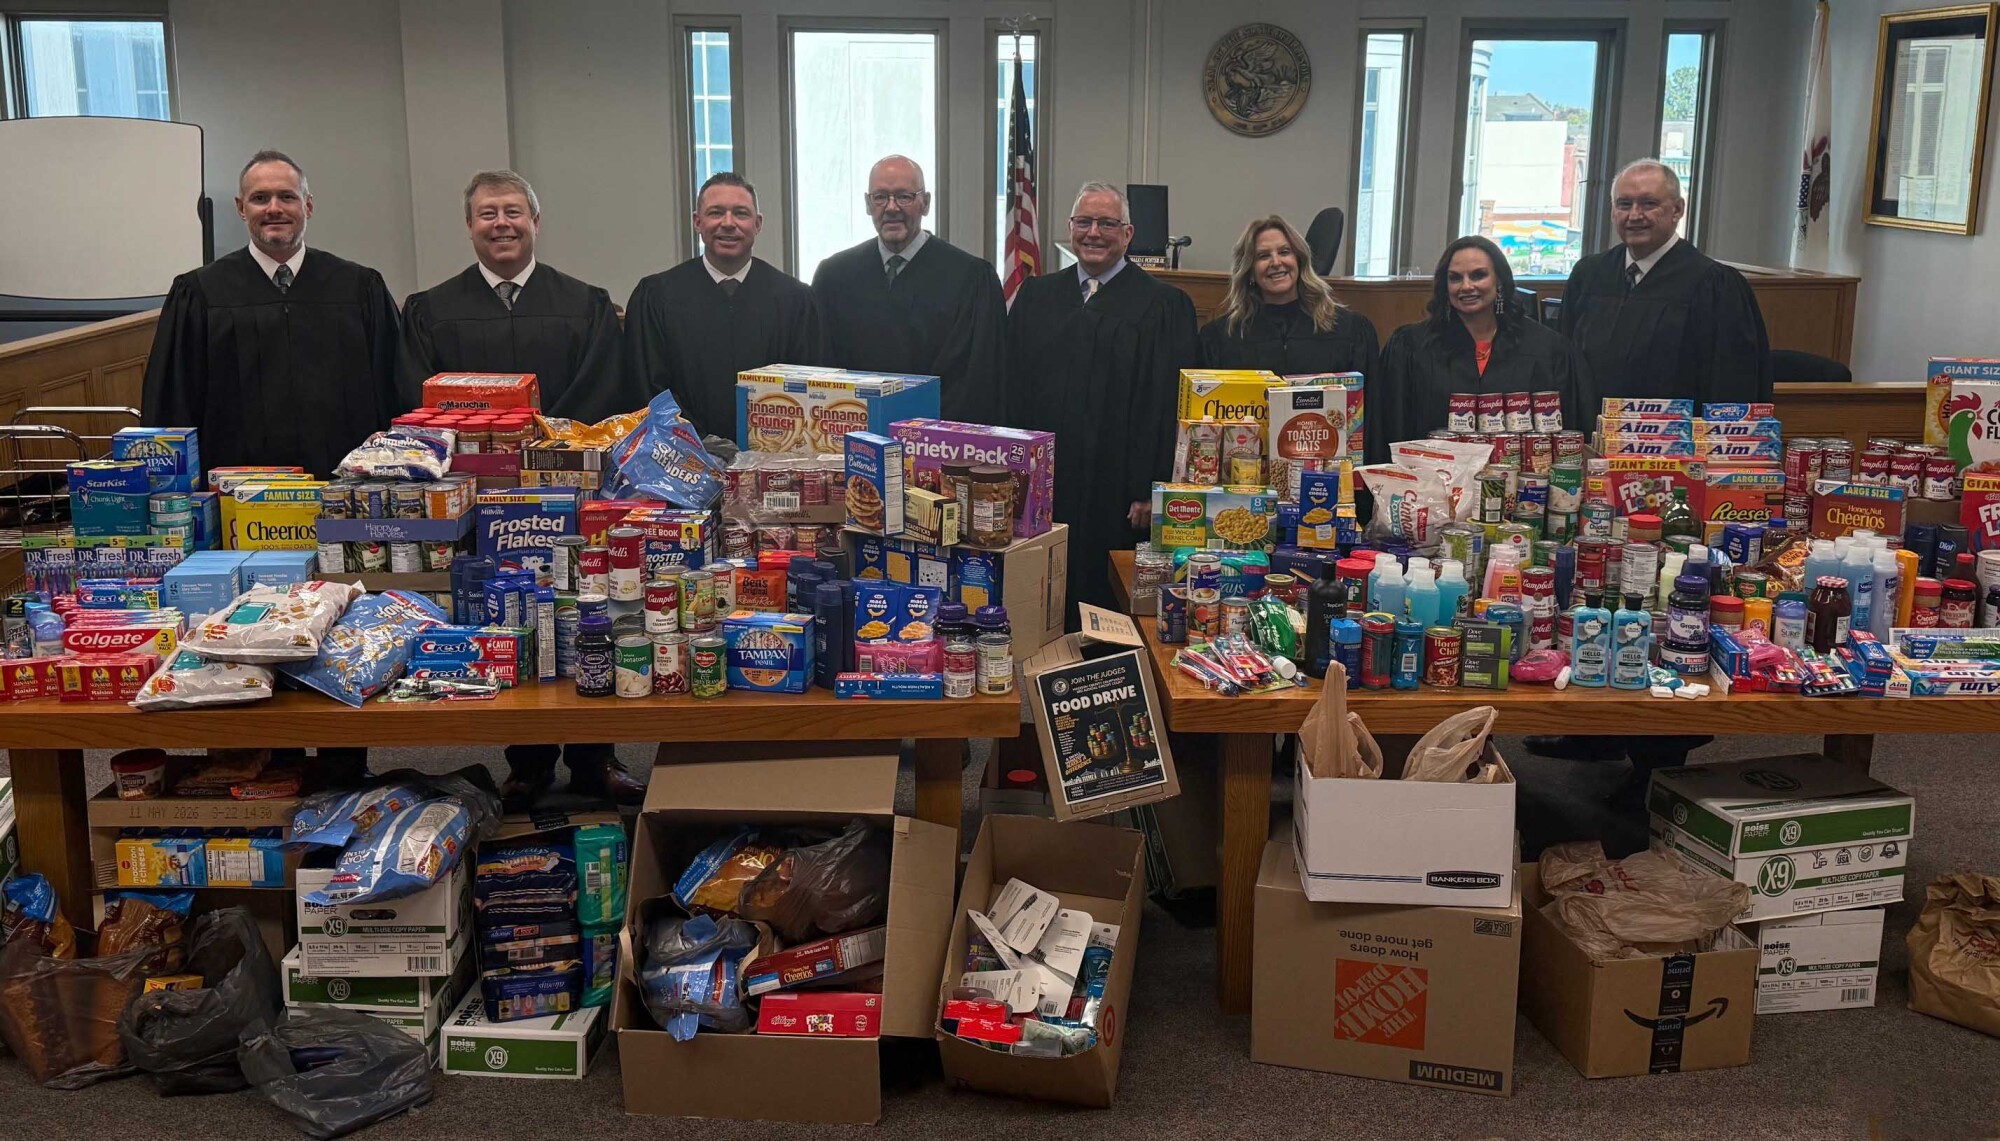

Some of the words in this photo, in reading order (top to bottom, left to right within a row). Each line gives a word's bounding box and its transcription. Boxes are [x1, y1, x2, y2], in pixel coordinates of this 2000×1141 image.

[1943, 365, 1979, 375] GIANT
[1982, 366, 2000, 375] SIZ
[739, 374, 761, 383] FAMILY
[808, 380, 831, 388] FAMILY
[832, 381, 846, 389] SIZE
[447, 401, 490, 409] Maruchan
[1620, 400, 1663, 413] Aim
[811, 405, 867, 422] Cinnamo
[750, 413, 796, 429] CRUNCH
[1617, 421, 1660, 434] Aim
[1707, 423, 1749, 436] Aim
[1287, 429, 1329, 440] TOASTED
[893, 436, 959, 461] Variety
[963, 443, 1008, 466] Pack
[1011, 445, 1023, 455] 25
[1296, 440, 1320, 452] OATS
[1557, 442, 1580, 450] CHUNKY
[1620, 441, 1663, 455] Aim
[1708, 442, 1750, 455] Aim
[657, 444, 682, 466] OAT
[1608, 460, 1645, 470] GIANT
[1649, 460, 1676, 470] SIZE
[1826, 457, 1850, 465] CHUNKY
[650, 452, 703, 485] BLENDERS
[87, 479, 128, 488] StarKist
[1732, 475, 1757, 483] LARGE
[1760, 474, 1778, 483] SIZE
[1966, 479, 2000, 490] GIAN
[264, 491, 294, 501] FAMILY
[296, 490, 315, 500] SIZE
[1843, 485, 1870, 497] LARGE
[1871, 488, 1890, 499] SIZE
[91, 495, 110, 503] Chunk
[111, 495, 126, 504] Light
[1254, 497, 1262, 506] 8
[1168, 505, 1180, 513] Del
[1180, 505, 1201, 514] Monte
[1591, 511, 1611, 519] HEARTY
[1711, 501, 1772, 522] Reese's
[1784, 505, 1808, 514] CHUNKY
[1848, 505, 1868, 516] Honey
[1869, 506, 1882, 515] Nut
[1826, 508, 1886, 529] Cheerios
[246, 522, 317, 541] Cheerios
[365, 523, 393, 533] Happy
[489, 515, 566, 539] Frosted
[1589, 523, 1609, 531] Chicken
[370, 531, 405, 539] Harvest
[496, 532, 556, 552] Flakes
[1939, 541, 1954, 551] Dial
[130, 550, 148, 561] DR.
[150, 549, 181, 561] Fresh
[646, 552, 685, 563] ROSTED
[743, 576, 768, 588] Ben's
[743, 587, 768, 595] Original
[81, 594, 116, 603] Crest
[737, 595, 759, 606] Ready
[759, 595, 775, 606] Rice
[11, 600, 23, 610] 2
[8, 624, 28, 636] SPEED
[1680, 622, 1701, 630] Grape
[161, 633, 169, 643] 3
[1781, 629, 1801, 638] Sure
[68, 632, 143, 649] Colgate
[492, 640, 514, 649] CAVITY
[420, 641, 467, 654] Crest
[623, 656, 647, 664] potatoes
[738, 650, 787, 660] TAMPAX
[1464, 658, 1480, 666] Dove
[415, 667, 465, 679] Crest
[491, 665, 514, 673] CAVITY
[1070, 676, 1086, 685] JOIN
[1086, 672, 1100, 681] THE
[1100, 667, 1126, 679] JUDGES
[14, 687, 39, 695] Raisins
[1051, 696, 1091, 716] FOOD
[1092, 685, 1137, 706] DRIVE
[124, 788, 143, 798] CHILI
[147, 807, 167, 818] MAY
[173, 807, 200, 819] 2026
[1744, 829, 1770, 838] PAPER
[1784, 826, 1797, 841] X9
[129, 845, 137, 884] macaroni
[1836, 855, 1850, 864] USA
[1430, 876, 1474, 884] BANKERS
[1475, 876, 1497, 884] BOX
[1821, 874, 1849, 885] MULTI-USE
[1848, 872, 1863, 882] COPY
[1862, 870, 1880, 880] PAPER
[304, 907, 337, 915] PAPER
[327, 919, 344, 934] X9
[1337, 929, 1372, 943] done.
[1375, 935, 1409, 947] more
[1411, 937, 1433, 950] get
[1350, 943, 1387, 957] doers
[1391, 948, 1419, 961] How
[1667, 965, 1692, 975] prime
[1780, 959, 1794, 974] X9
[784, 969, 814, 983] Cheerios
[331, 982, 348, 997] X9
[1334, 963, 1392, 1012] DEPOT
[1336, 966, 1428, 1040] HOME
[1377, 1008, 1418, 1039] THE
[1657, 1022, 1682, 1032] prime
[490, 1050, 503, 1065] X9
[1416, 1064, 1496, 1087] MEDIUM
